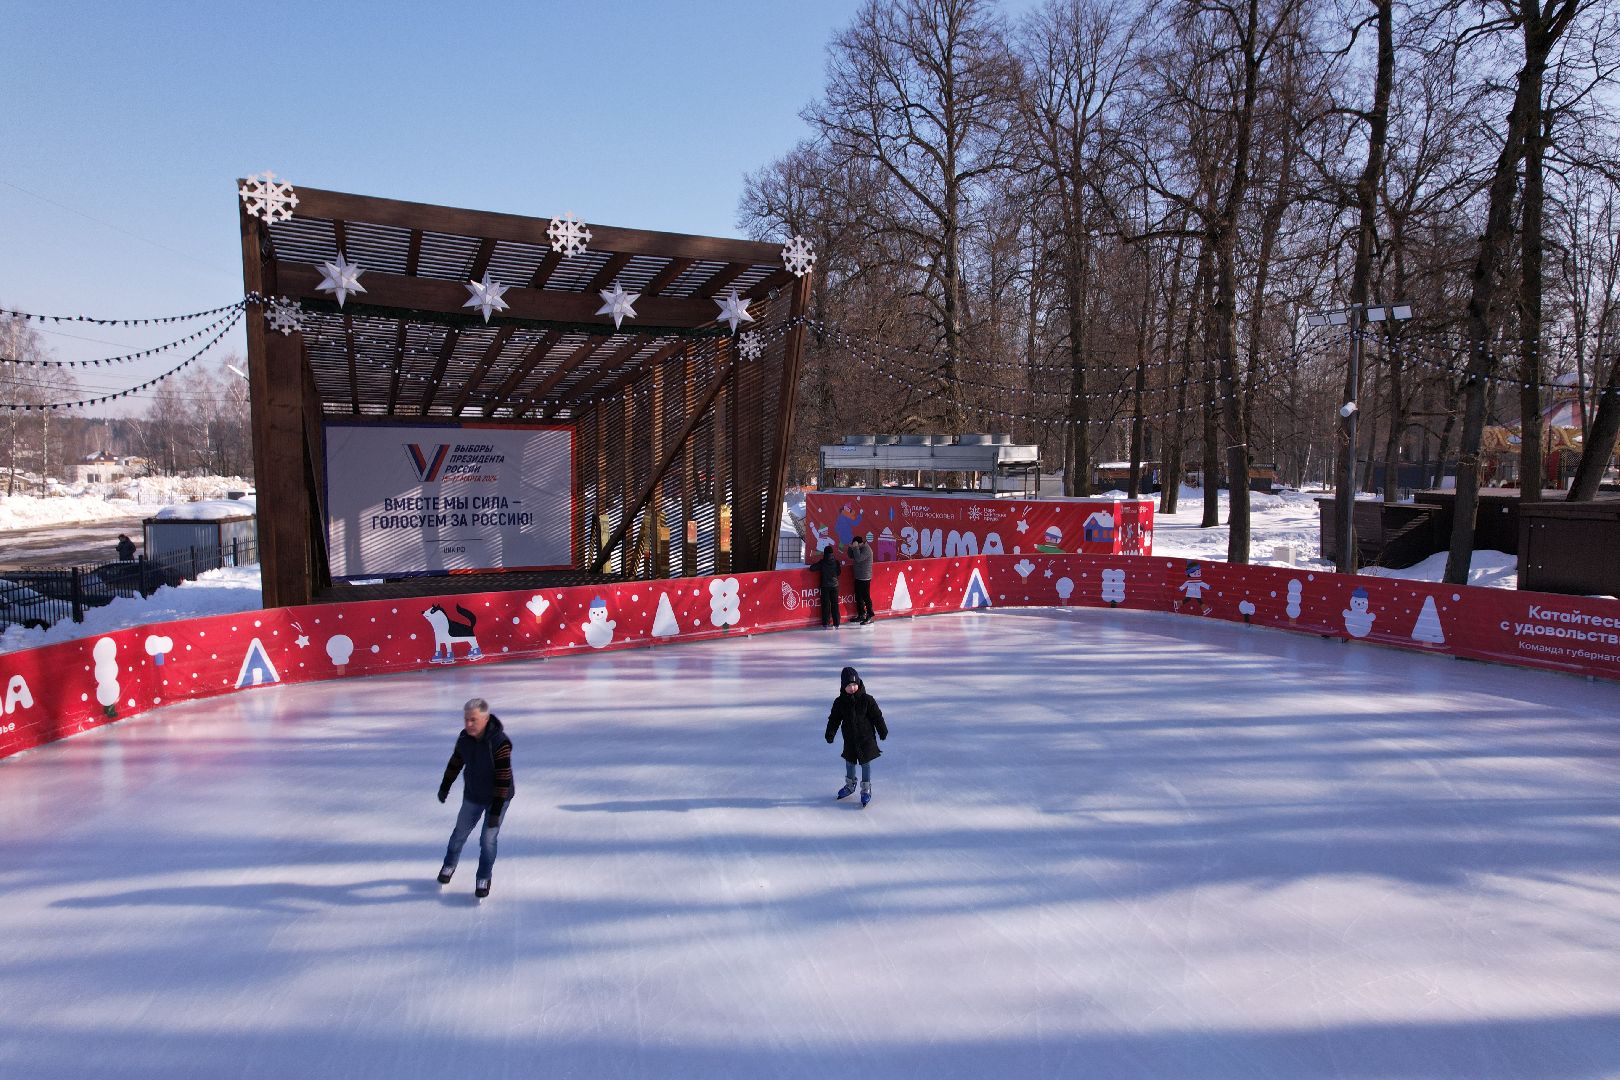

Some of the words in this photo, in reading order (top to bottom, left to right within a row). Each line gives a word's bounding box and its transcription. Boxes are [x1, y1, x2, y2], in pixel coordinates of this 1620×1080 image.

[454, 444, 494, 453] ВЫБОРЫ
[449, 455, 505, 463] ПРЕЗИДЕНТА
[445, 465, 481, 474] РОССИИ
[384, 497, 440, 511] ВМЕСТЕ
[443, 497, 469, 510] МЫ
[472, 496, 509, 510] СИЛА
[372, 513, 447, 530] ГОЛОСУЕМ
[450, 513, 468, 527] ЗА
[472, 512, 533, 526] РОССИЮ!
[1528, 605, 1620, 629] Катайтесь
[1500, 620, 1510, 631] с
[1514, 622, 1620, 645] удовольств
[1519, 641, 1564, 655] Команда
